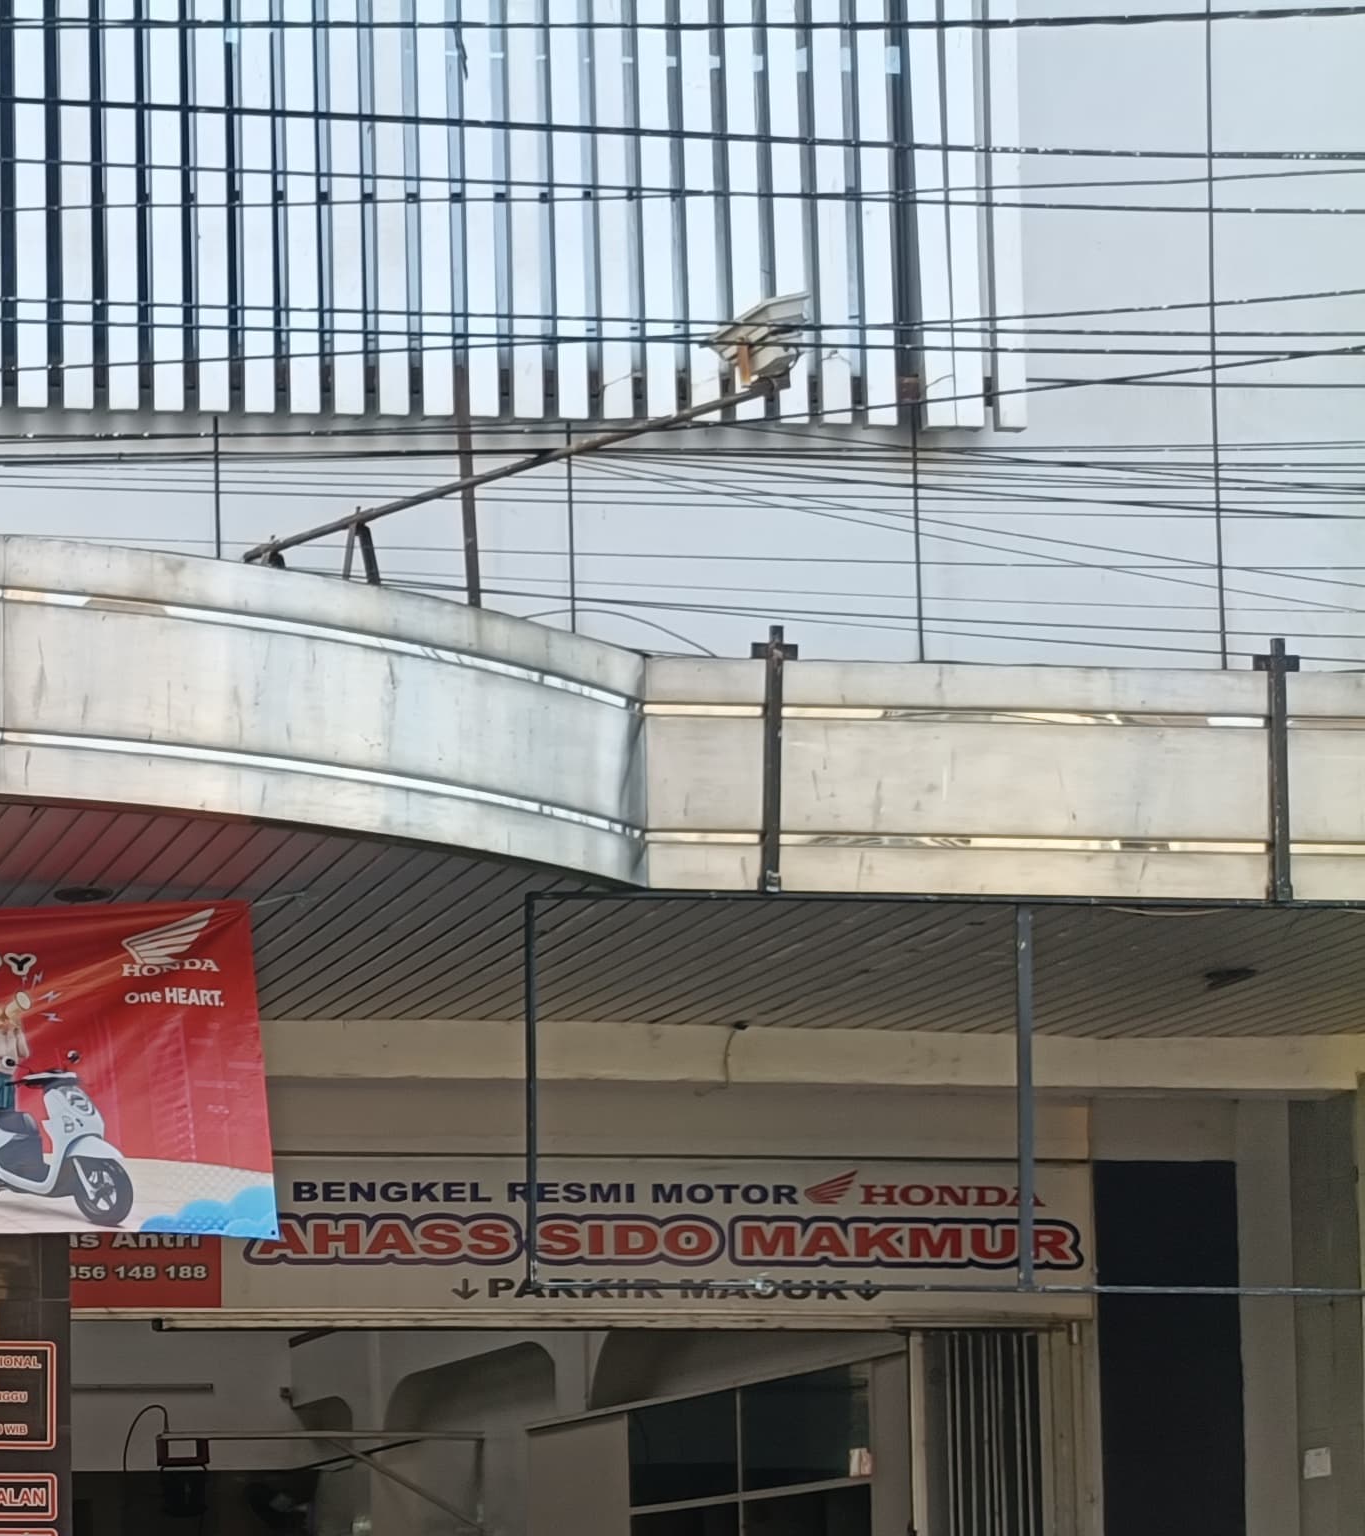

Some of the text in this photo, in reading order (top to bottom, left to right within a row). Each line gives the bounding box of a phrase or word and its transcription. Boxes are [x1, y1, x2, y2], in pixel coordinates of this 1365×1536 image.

[121, 958, 221, 977] HONDA
[164, 986, 225, 1007] HEART.
[292, 1181, 1046, 1207] BENGKEL RESMI MOTOR HONDA
[256, 1221, 1075, 1262] AHASS SIDO MAKMUR
[114, 1265, 157, 1281] 148
[164, 1265, 208, 1281] 188
[487, 1278, 666, 1300] PARKIR
